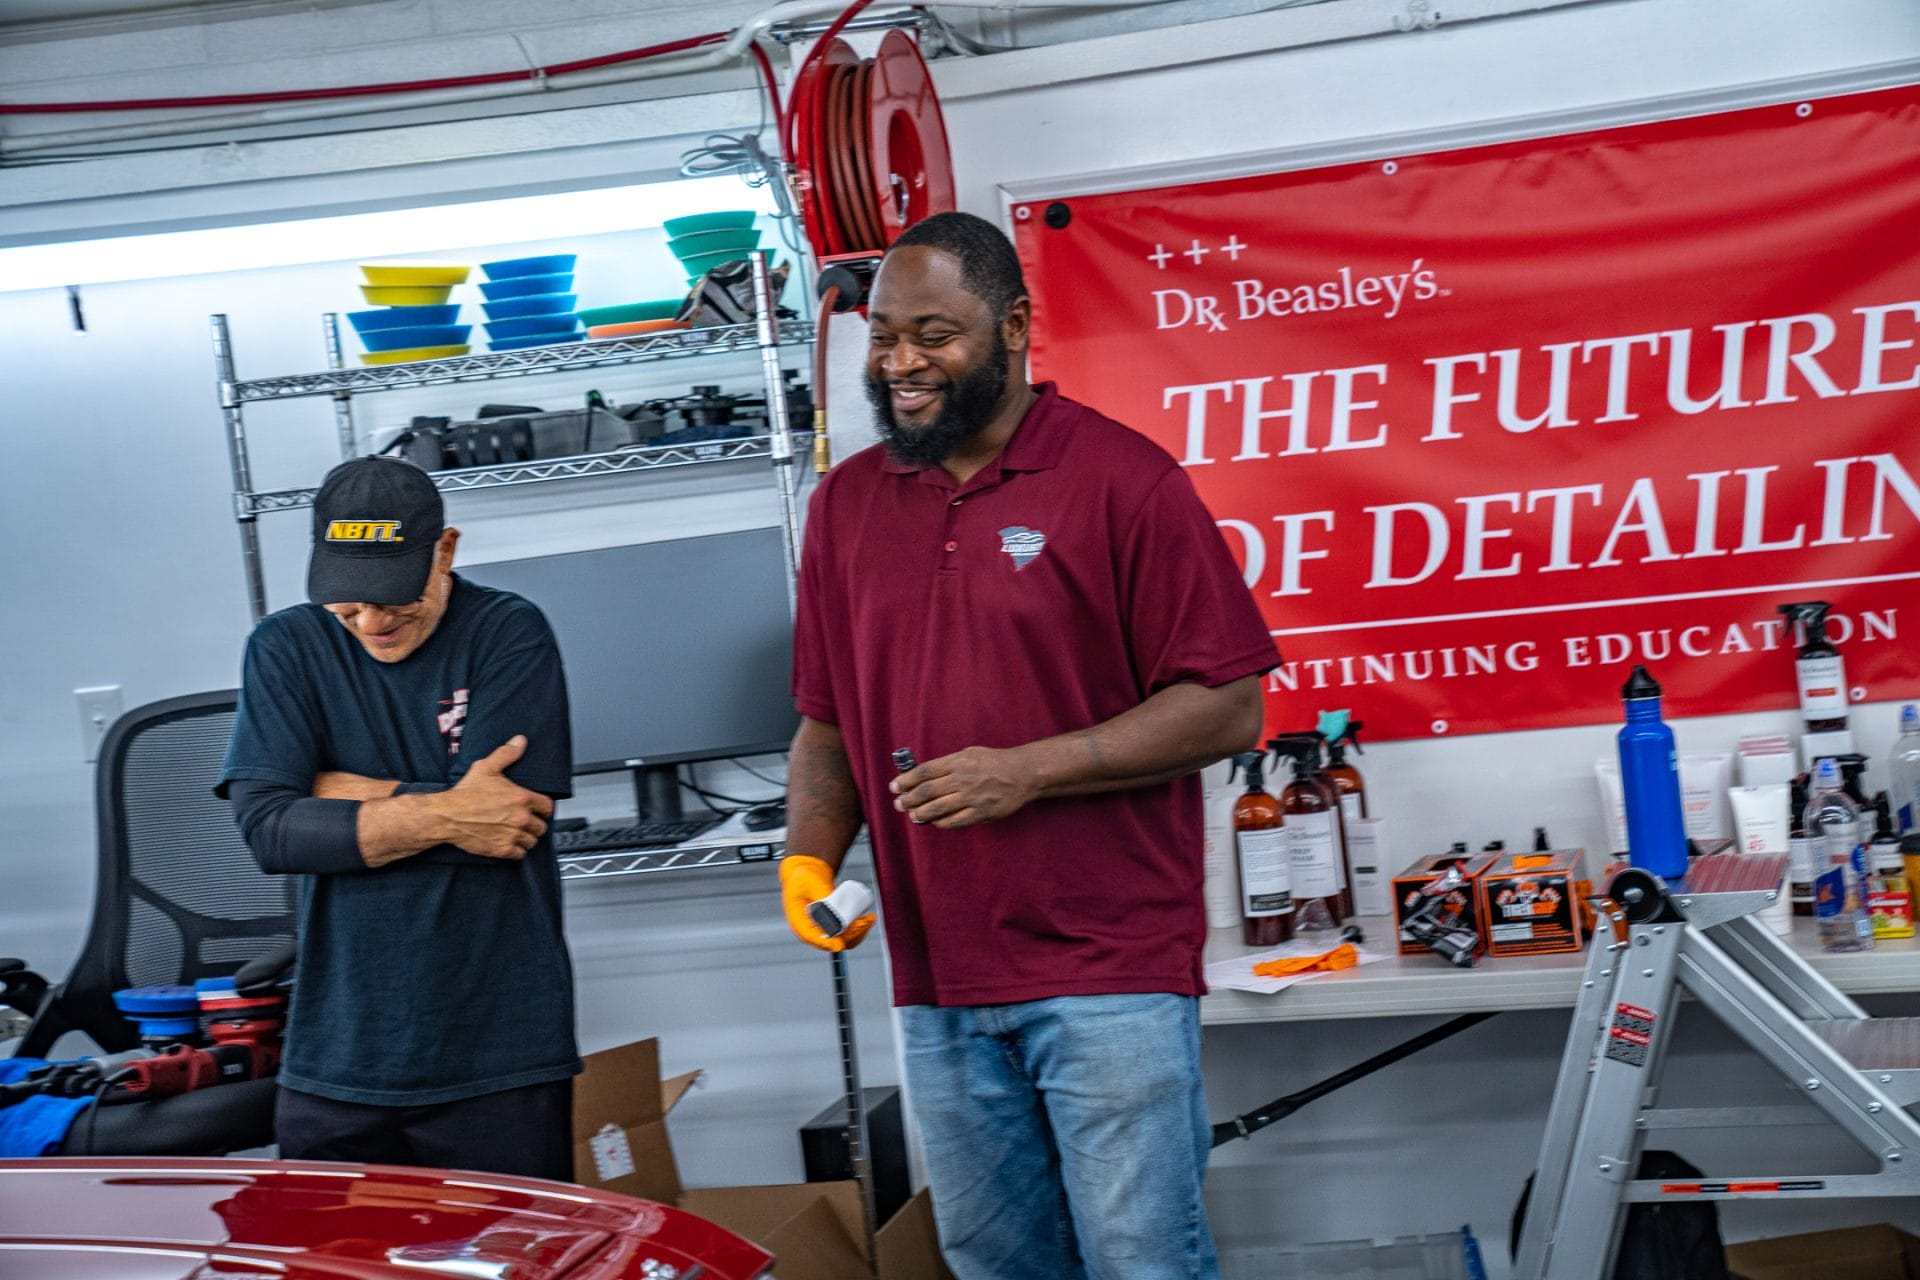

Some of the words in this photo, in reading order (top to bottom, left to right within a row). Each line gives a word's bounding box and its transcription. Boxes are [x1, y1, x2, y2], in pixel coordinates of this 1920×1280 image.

[1232, 258, 1438, 319] Beasley's
[1163, 364, 1388, 467] THE
[1420, 301, 1920, 442] FUTURE
[1267, 641, 1540, 693] NTINUING
[1562, 608, 1898, 668] EDUCATION
